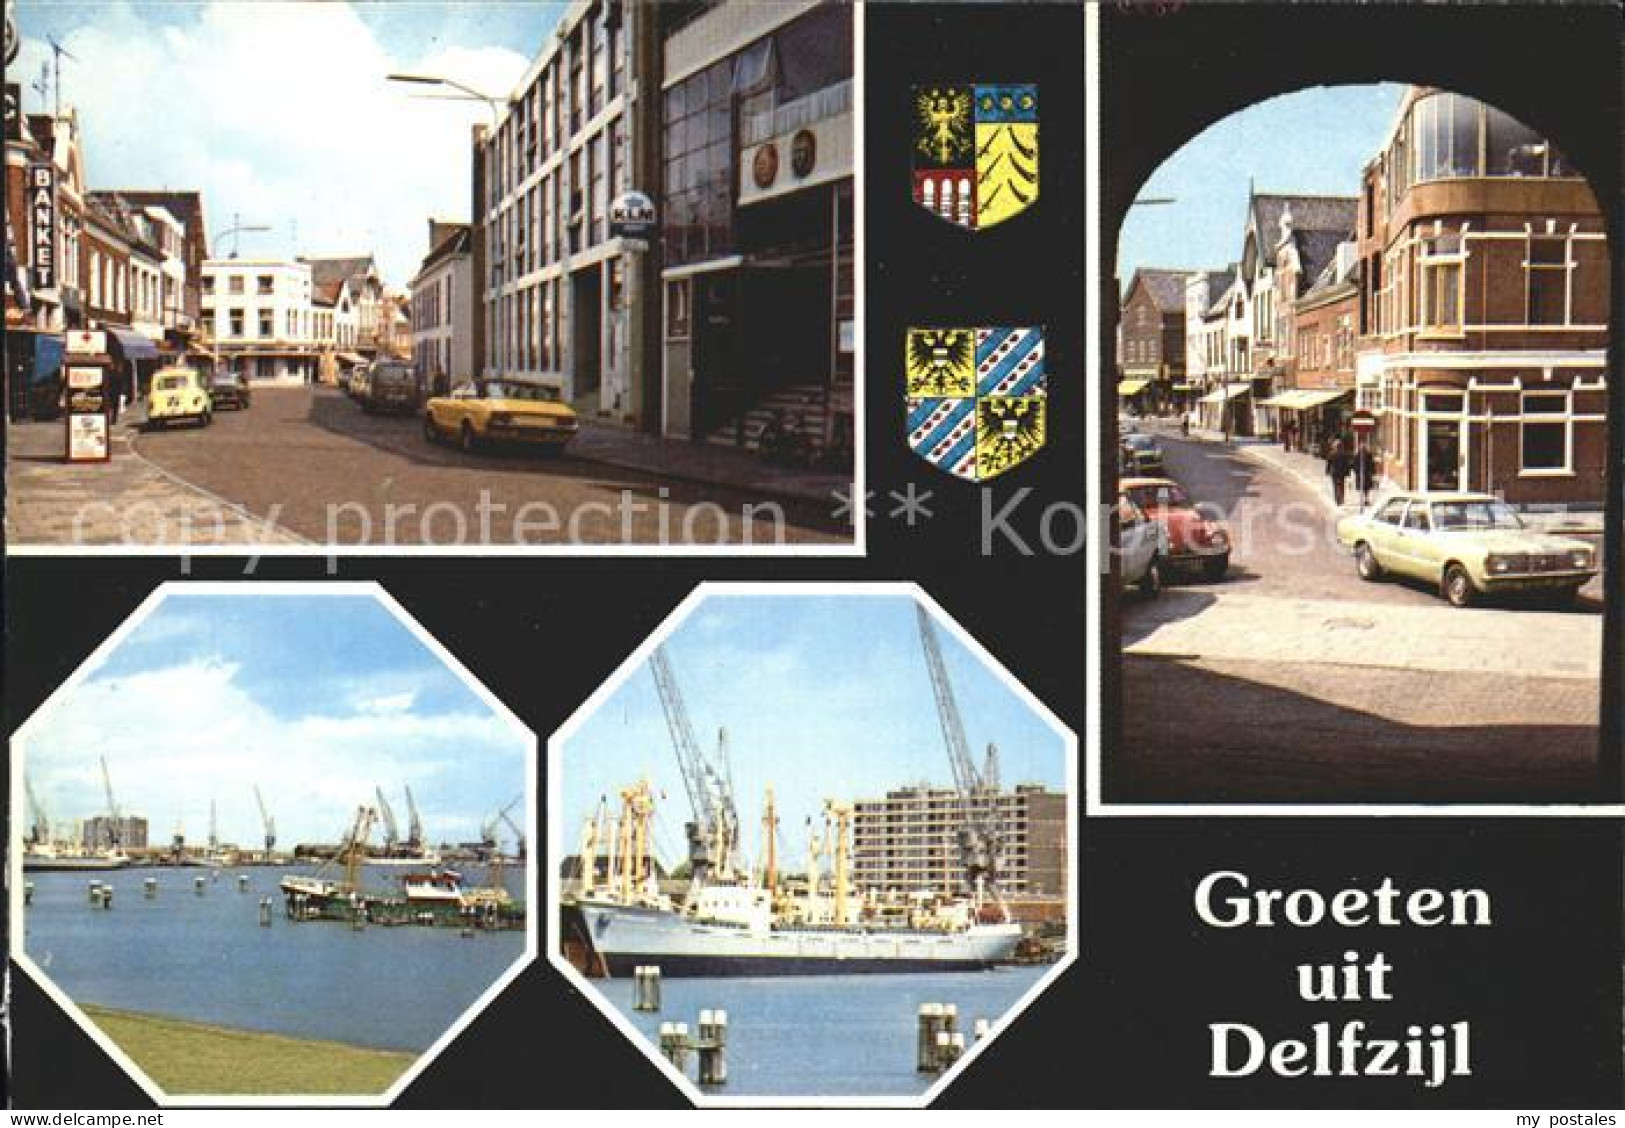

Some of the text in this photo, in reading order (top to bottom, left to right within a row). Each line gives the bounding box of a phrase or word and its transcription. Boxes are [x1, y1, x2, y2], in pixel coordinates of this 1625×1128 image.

[35, 168, 52, 285] BANKET
[614, 208, 654, 222] KLM
[1194, 870, 1492, 928] Groeten
[1297, 950, 1393, 1001] uit
[1208, 1021, 1472, 1088] Delfzijl
